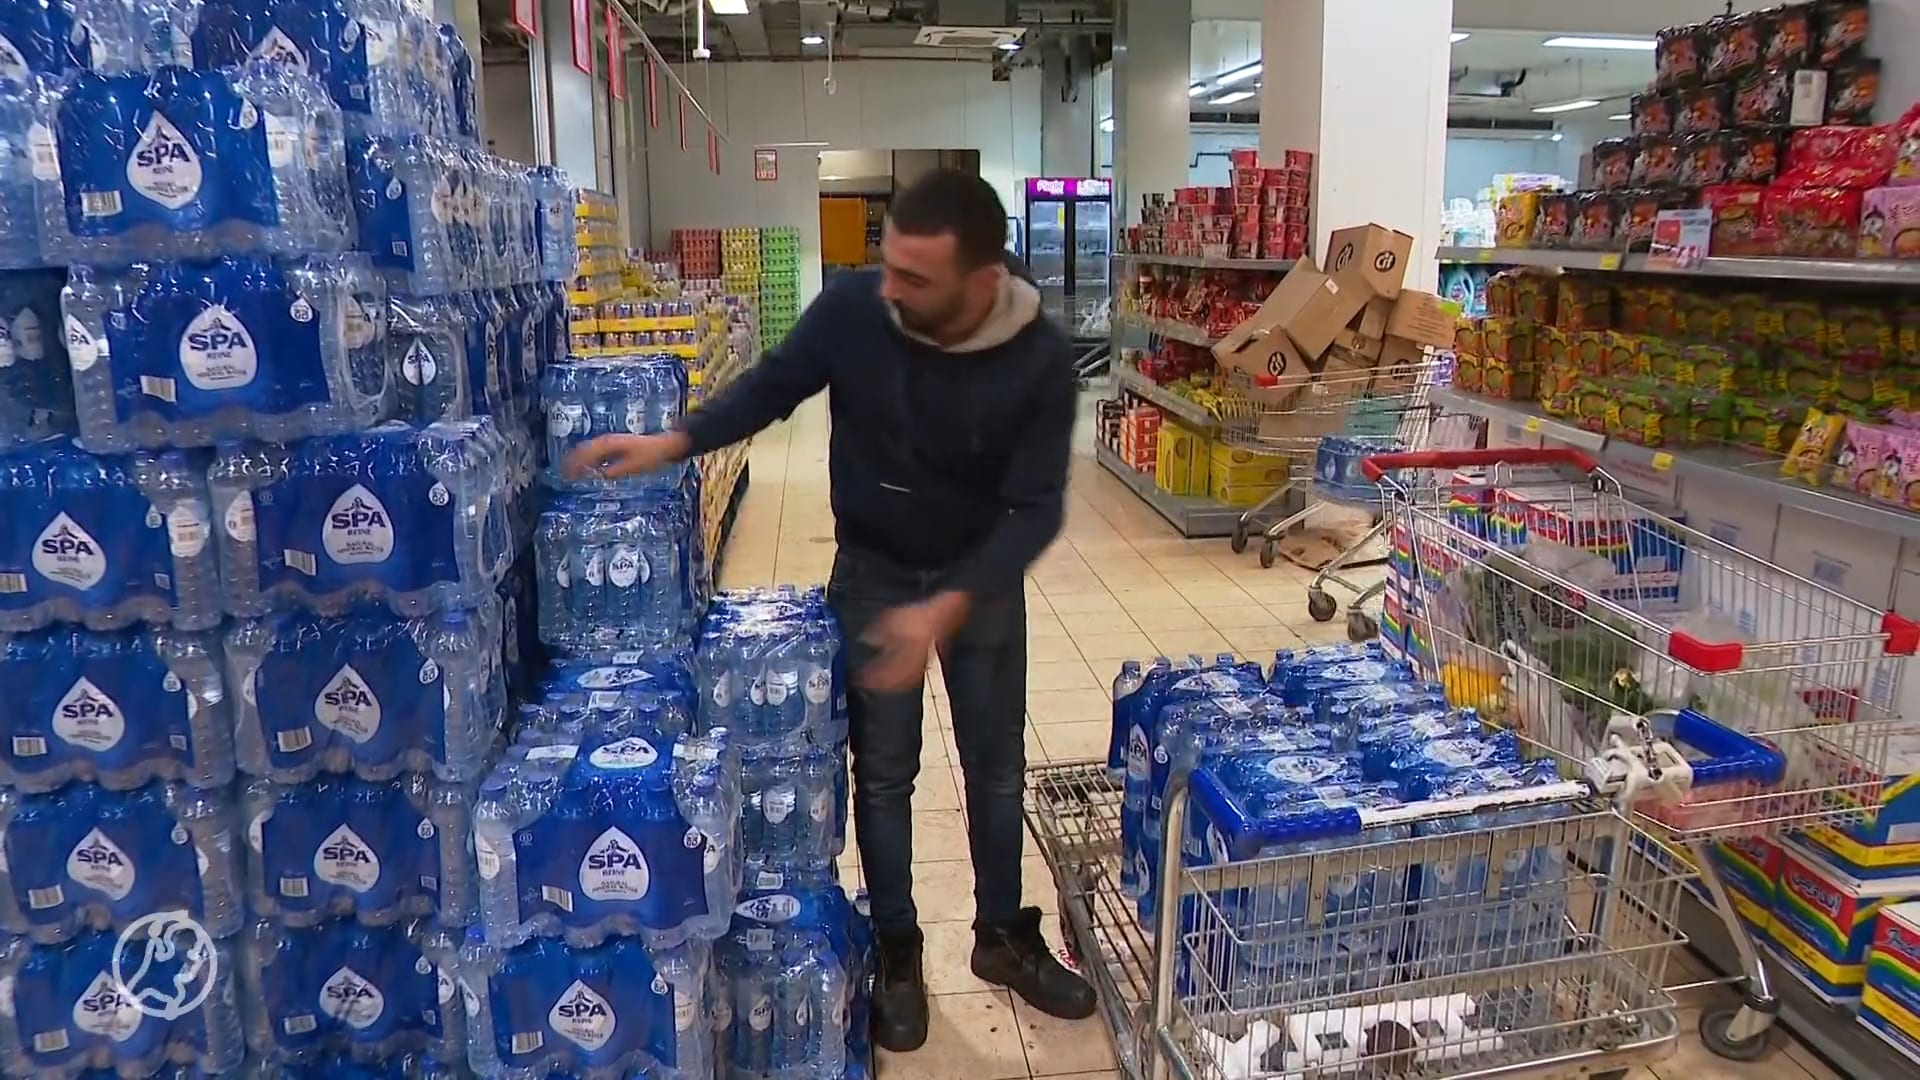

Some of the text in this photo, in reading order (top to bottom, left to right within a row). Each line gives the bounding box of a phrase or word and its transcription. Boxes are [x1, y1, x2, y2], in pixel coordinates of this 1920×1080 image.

[137, 143, 191, 167] SPA
[1375, 252, 1395, 269] Cif
[71, 332, 91, 346] PA
[189, 332, 249, 351] SPA
[332, 510, 387, 529] SPA
[41, 539, 96, 557] SPA
[324, 690, 373, 706] SPA
[62, 702, 115, 719] SPA
[77, 848, 125, 867] SPA
[323, 845, 372, 864] SPA
[588, 852, 642, 871] SPA
[327, 984, 375, 1000] SPA
[558, 1004, 607, 1020] SPA
